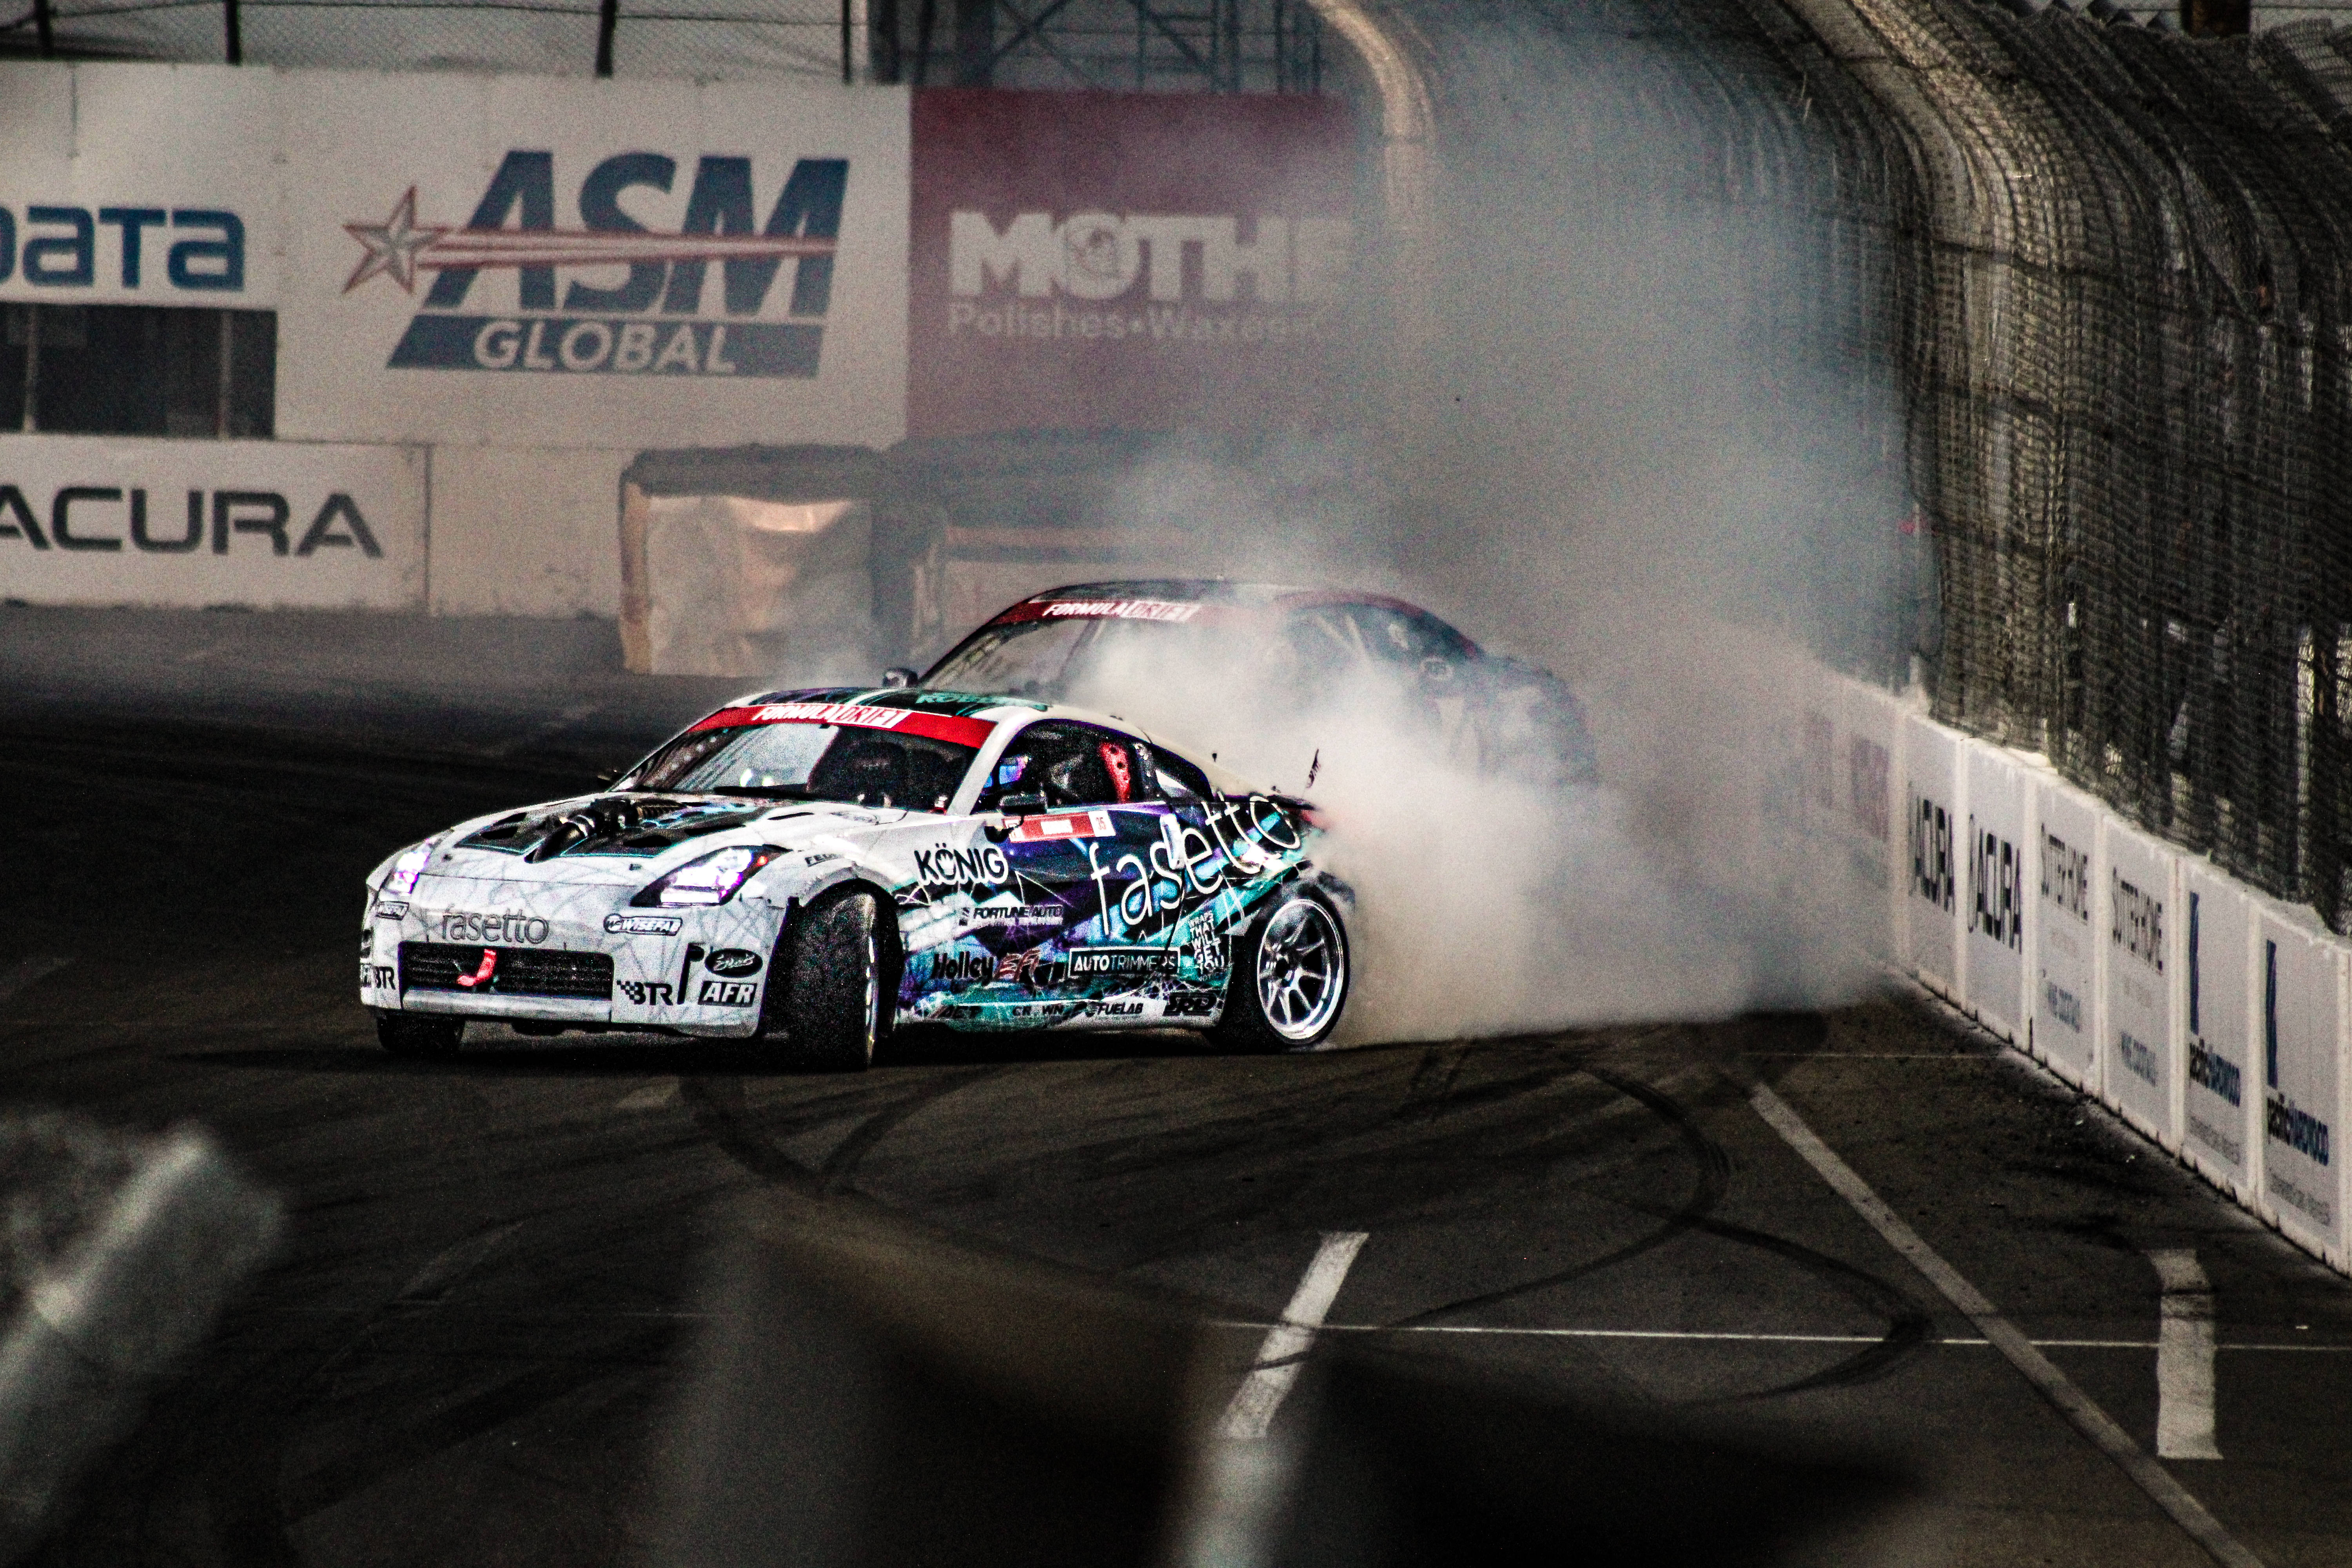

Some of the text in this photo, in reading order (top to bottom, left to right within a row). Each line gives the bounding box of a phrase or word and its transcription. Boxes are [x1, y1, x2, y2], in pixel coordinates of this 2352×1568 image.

[0, 205, 245, 291] aTa
[422, 151, 850, 314] ASM
[949, 209, 1351, 301] MOTHE
[473, 321, 737, 373] GLOBAL
[0, 484, 383, 557] ACURA
[752, 704, 905, 727] FORMULA DRIFT
[914, 842, 1006, 880] KÖNIG
[1089, 790, 1301, 935] fasetto
[1975, 826, 2023, 955] ACURA
[973, 907, 1031, 920] FORTUNE
[703, 982, 755, 1004] AFR
